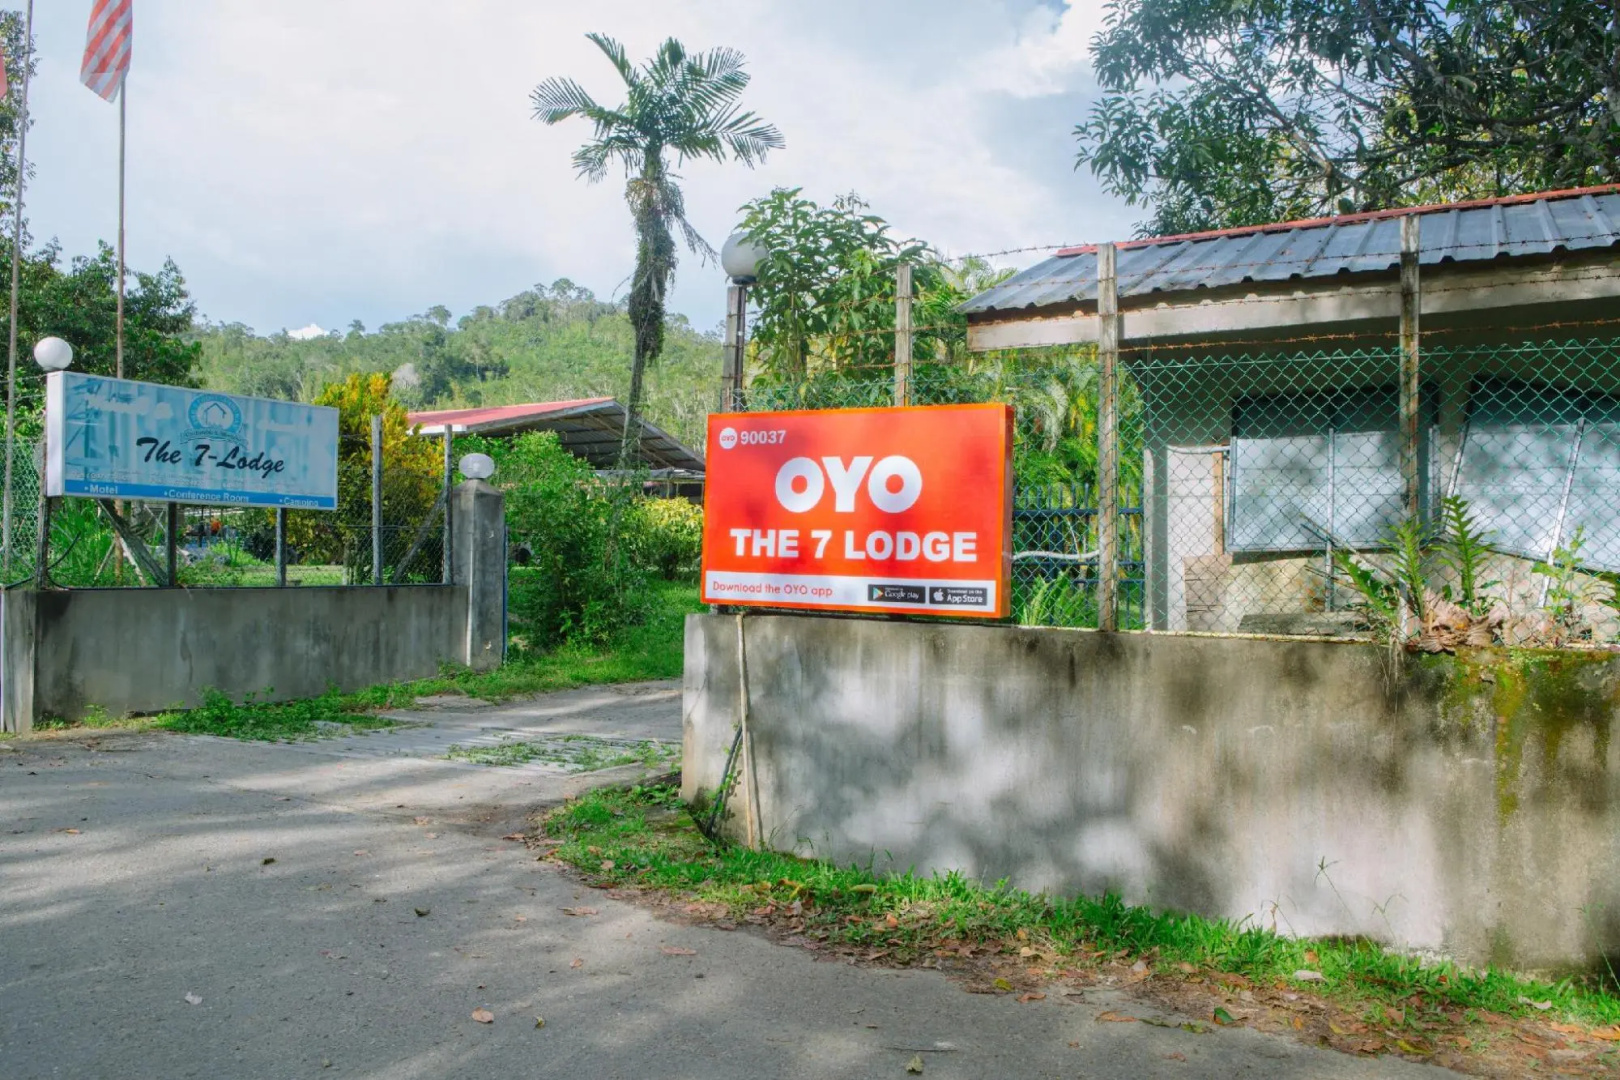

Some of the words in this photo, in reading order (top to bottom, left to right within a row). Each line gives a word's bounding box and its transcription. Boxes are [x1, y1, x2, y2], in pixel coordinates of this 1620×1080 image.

[740, 430, 786, 445] 90037
[136, 436, 182, 464] The
[194, 444, 285, 479] 7-Lodge
[775, 455, 922, 513] OYO
[89, 484, 118, 495] Motel
[168, 489, 221, 501] Conference
[223, 492, 249, 503] Room
[730, 528, 799, 558] THE
[811, 530, 832, 559] 7
[844, 530, 977, 562] LODGE
[713, 581, 762, 593] Download
[765, 584, 781, 594] the
[784, 584, 808, 595] OYO
[811, 587, 833, 598] app
[885, 591, 906, 600] Google
[907, 591, 920, 600] play
[947, 594, 962, 603] App
[963, 595, 983, 603] Store
